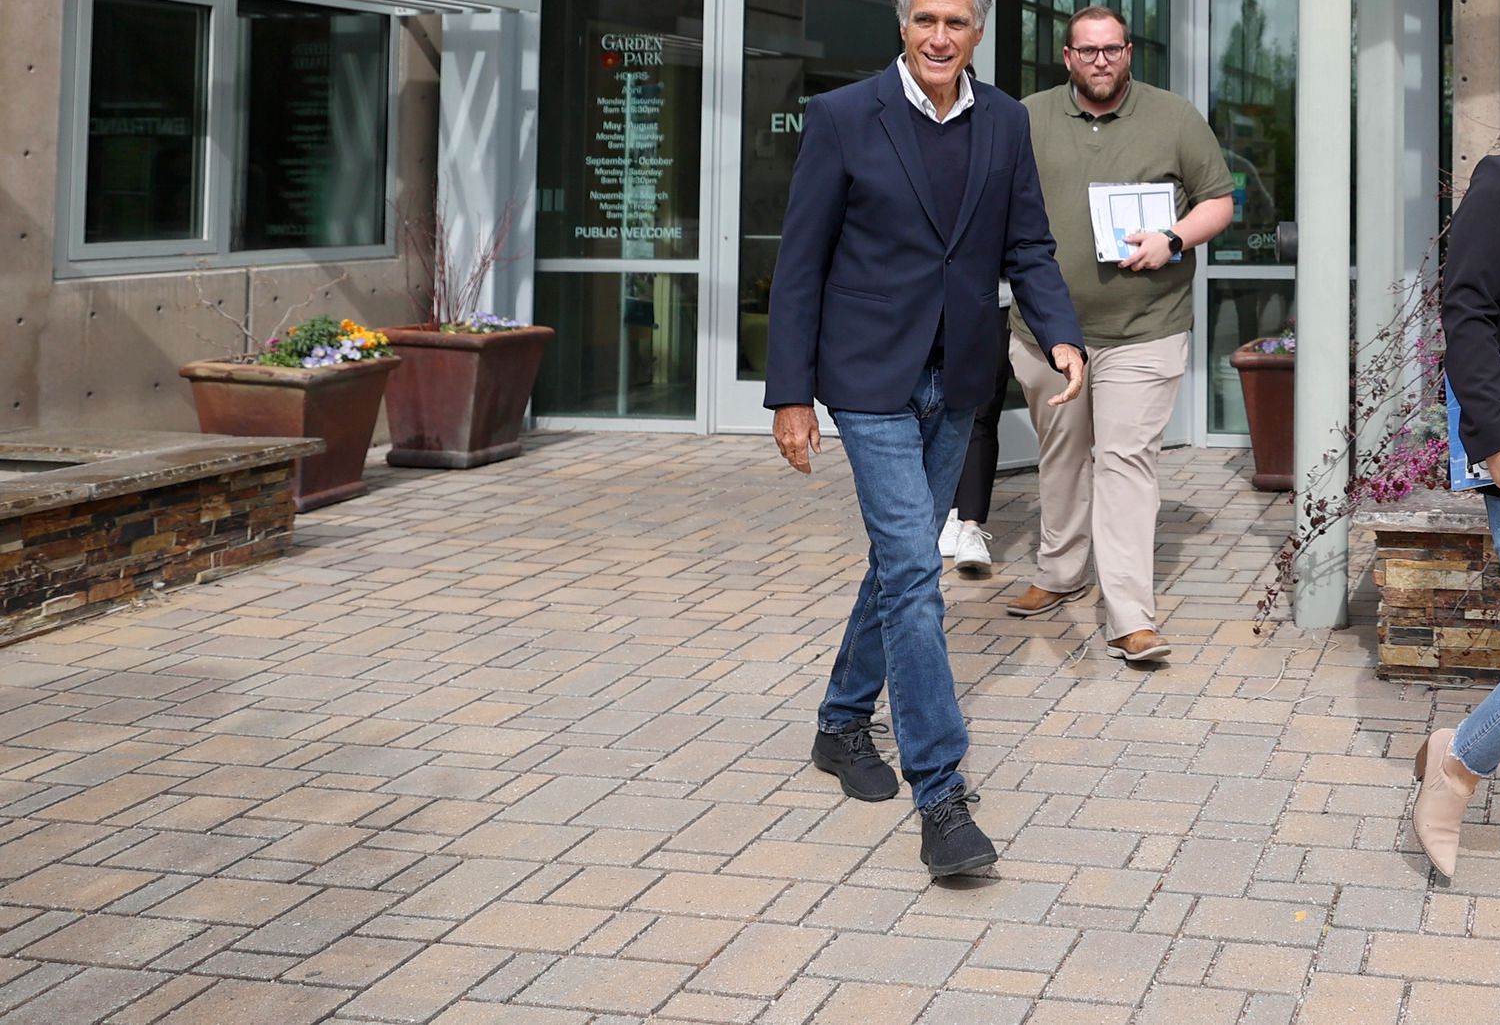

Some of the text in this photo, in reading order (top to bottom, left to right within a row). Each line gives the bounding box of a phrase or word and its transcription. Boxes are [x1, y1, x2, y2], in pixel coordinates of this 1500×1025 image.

[601, 34, 663, 51] GARDEN
[623, 51, 664, 67] PARK
[771, 113, 804, 133] EN
[575, 227, 682, 239] PUBLIC WELCOME
